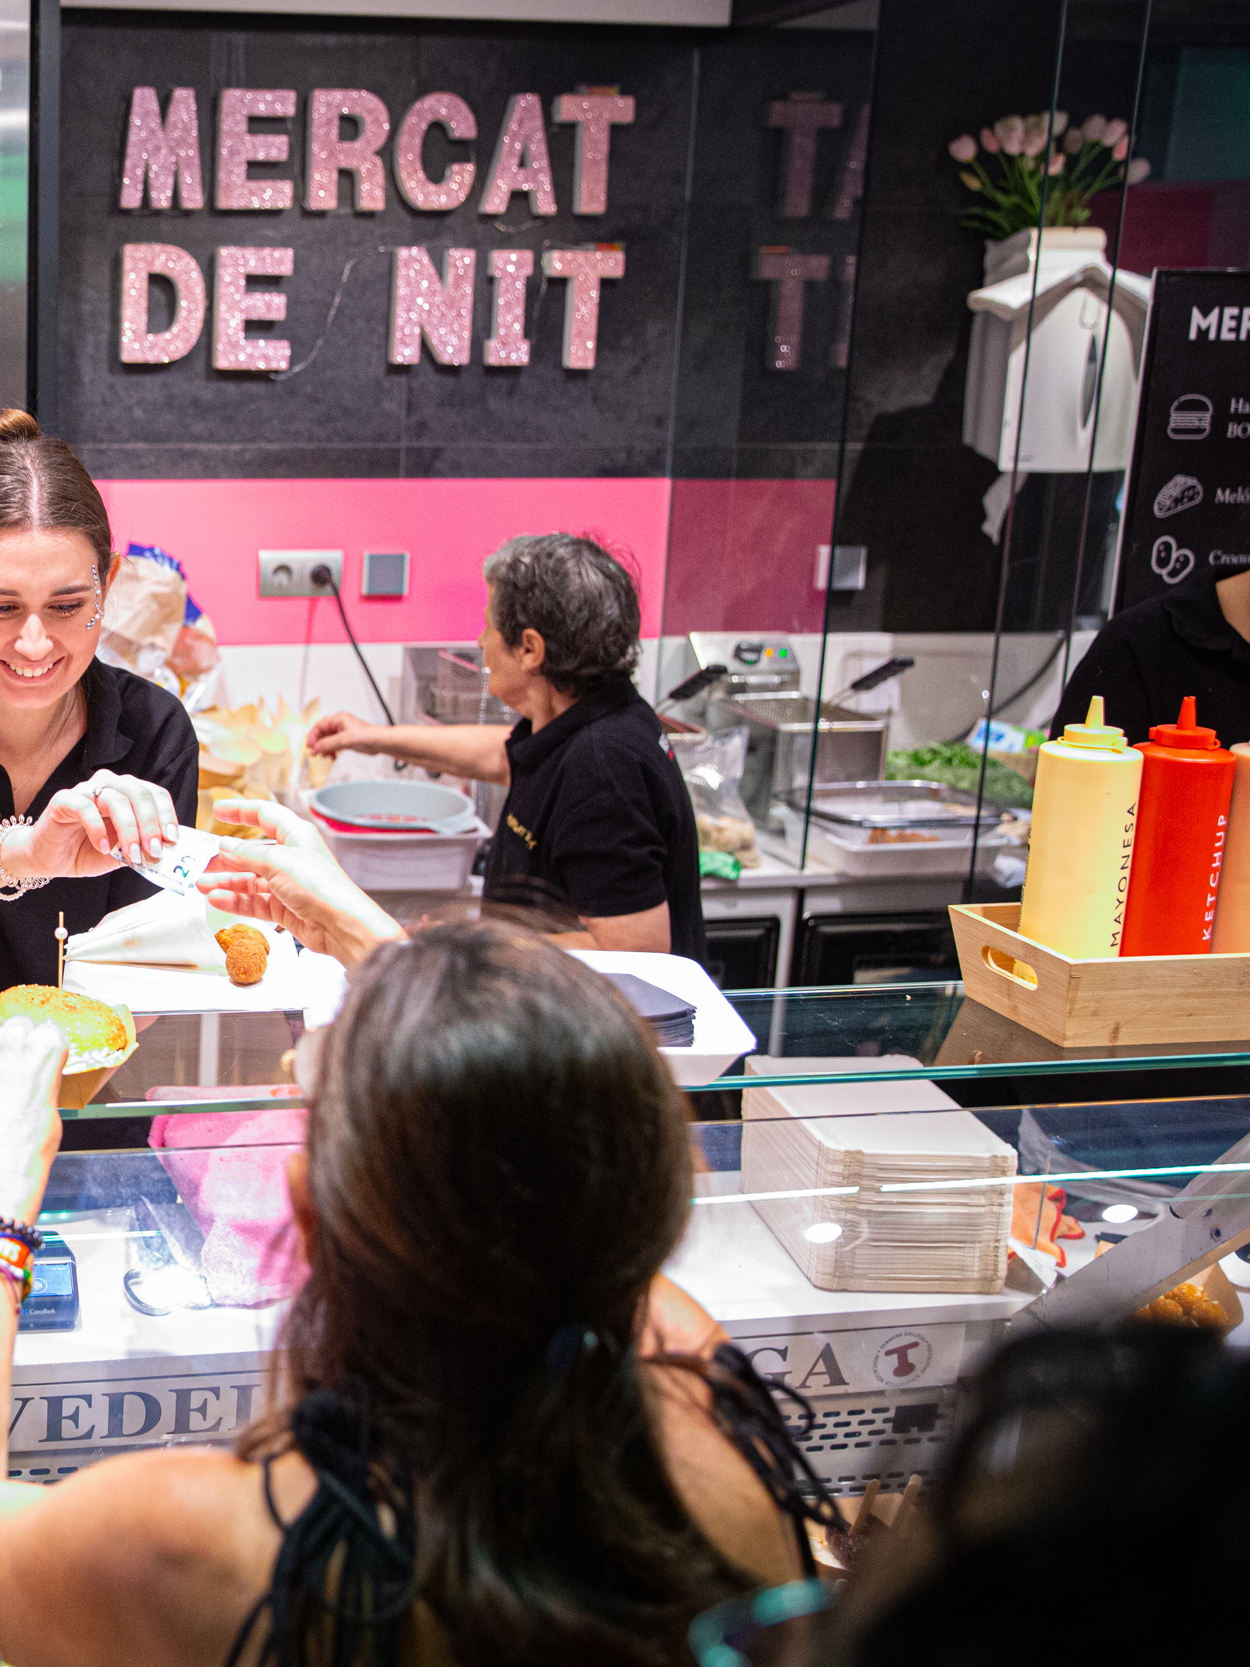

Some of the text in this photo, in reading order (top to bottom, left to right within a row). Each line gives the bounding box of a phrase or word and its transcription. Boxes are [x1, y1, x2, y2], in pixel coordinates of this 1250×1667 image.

[118, 86, 636, 215] MERCAT
[120, 243, 294, 371] DE
[387, 246, 626, 370] NIT
[1110, 802, 1137, 947] MAYONESA
[1202, 814, 1227, 941] KETCHUP
